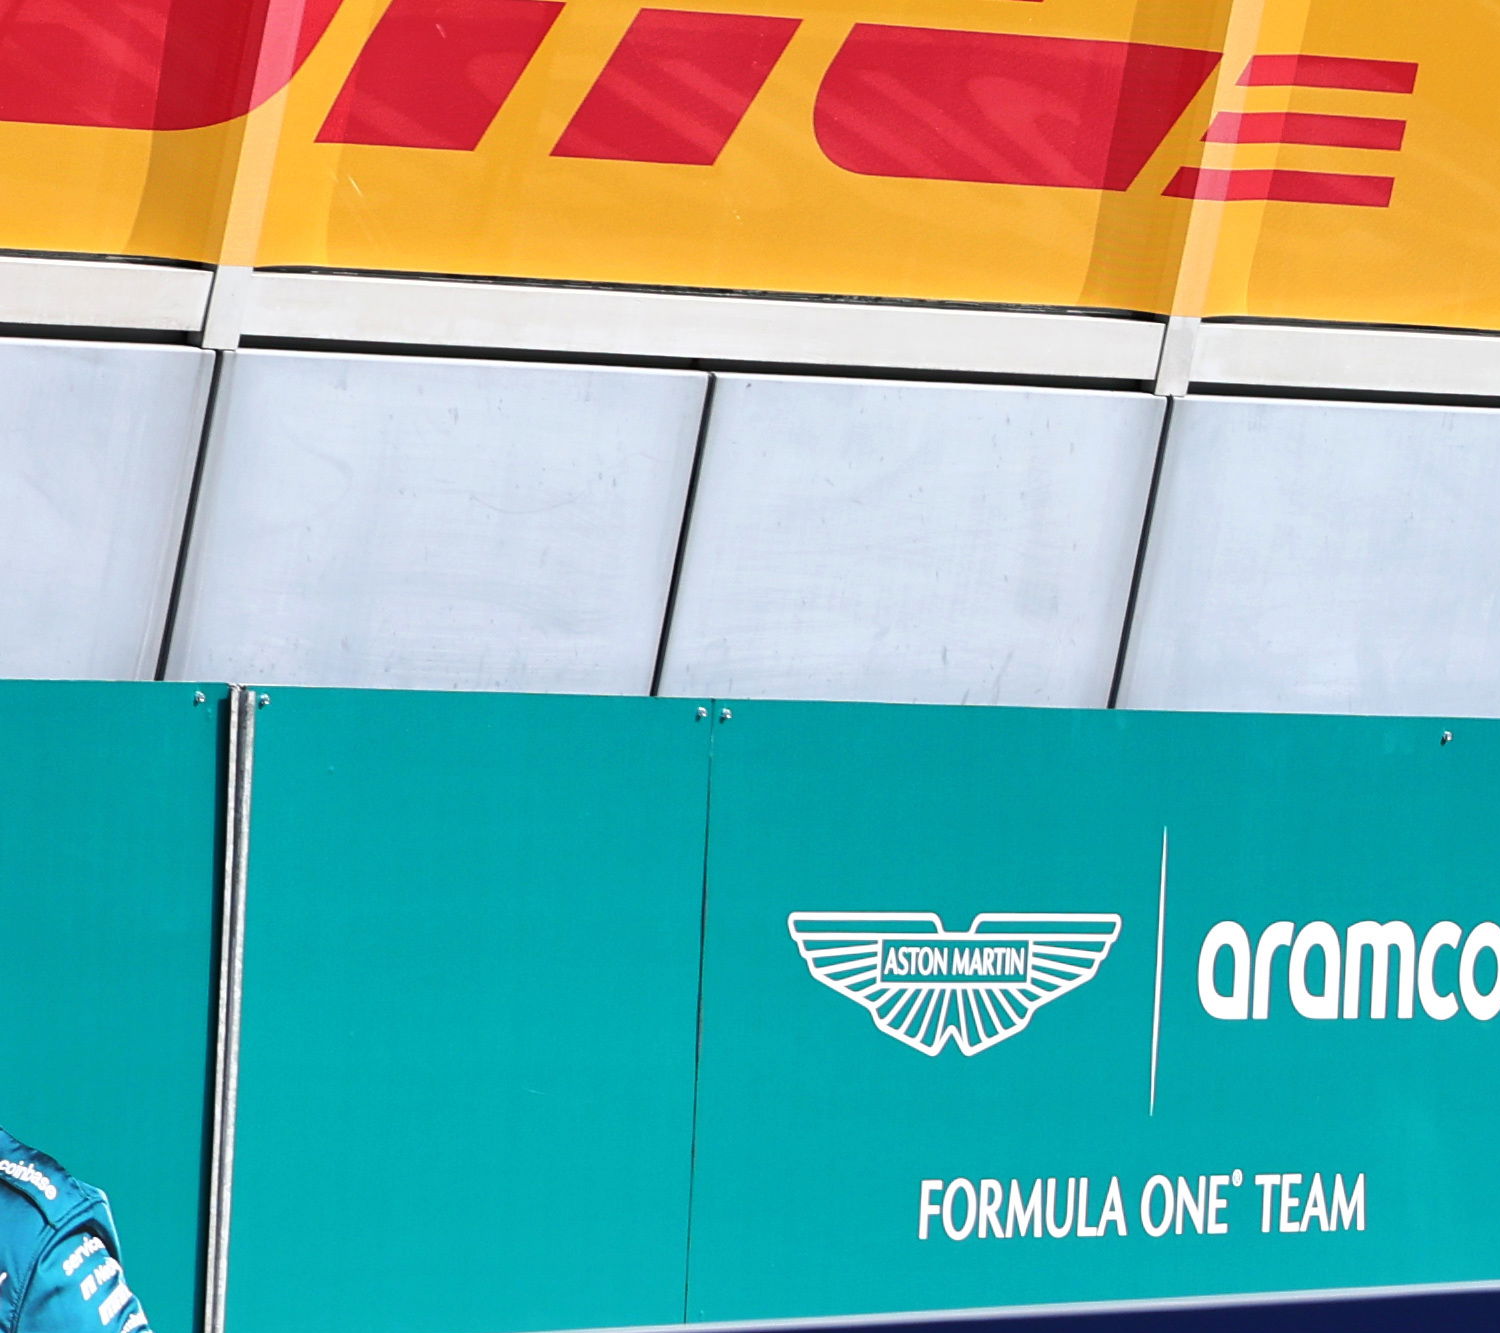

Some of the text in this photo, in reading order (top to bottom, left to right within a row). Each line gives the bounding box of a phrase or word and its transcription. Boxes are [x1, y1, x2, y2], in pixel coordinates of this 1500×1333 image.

[884, 945, 1026, 978] ASTON MARTIN
[918, 1175, 1128, 1241] FORMULA
[1255, 1172, 1366, 1234] TEAM
